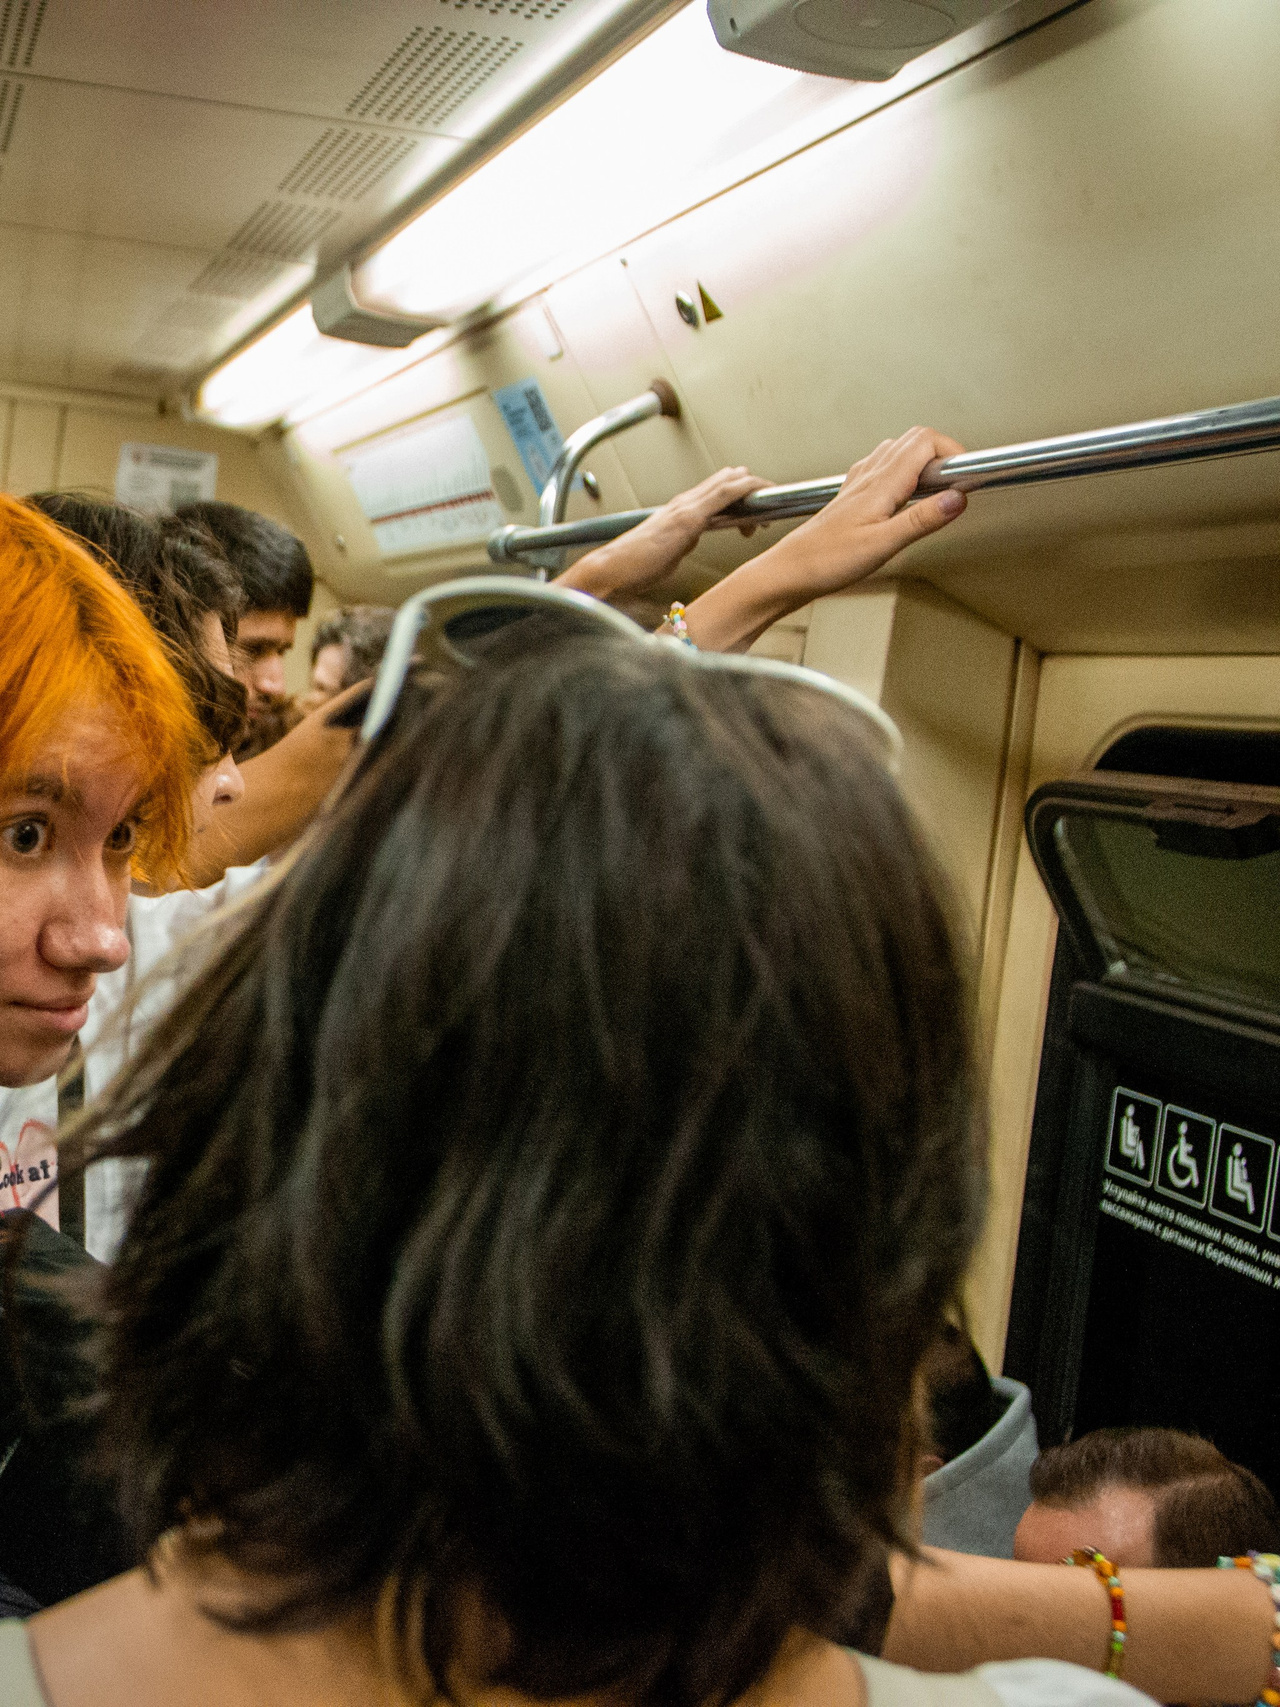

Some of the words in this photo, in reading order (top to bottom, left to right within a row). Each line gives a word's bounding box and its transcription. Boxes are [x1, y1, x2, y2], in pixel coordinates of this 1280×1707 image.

[29, 1159, 50, 1181] at
[1102, 1178, 1147, 1210] Уступайте
[1147, 1200, 1175, 1222] места
[1174, 1211, 1221, 1242] пожилым
[1161, 1226, 1197, 1252] детьми
[1196, 1242, 1205, 1256] и
